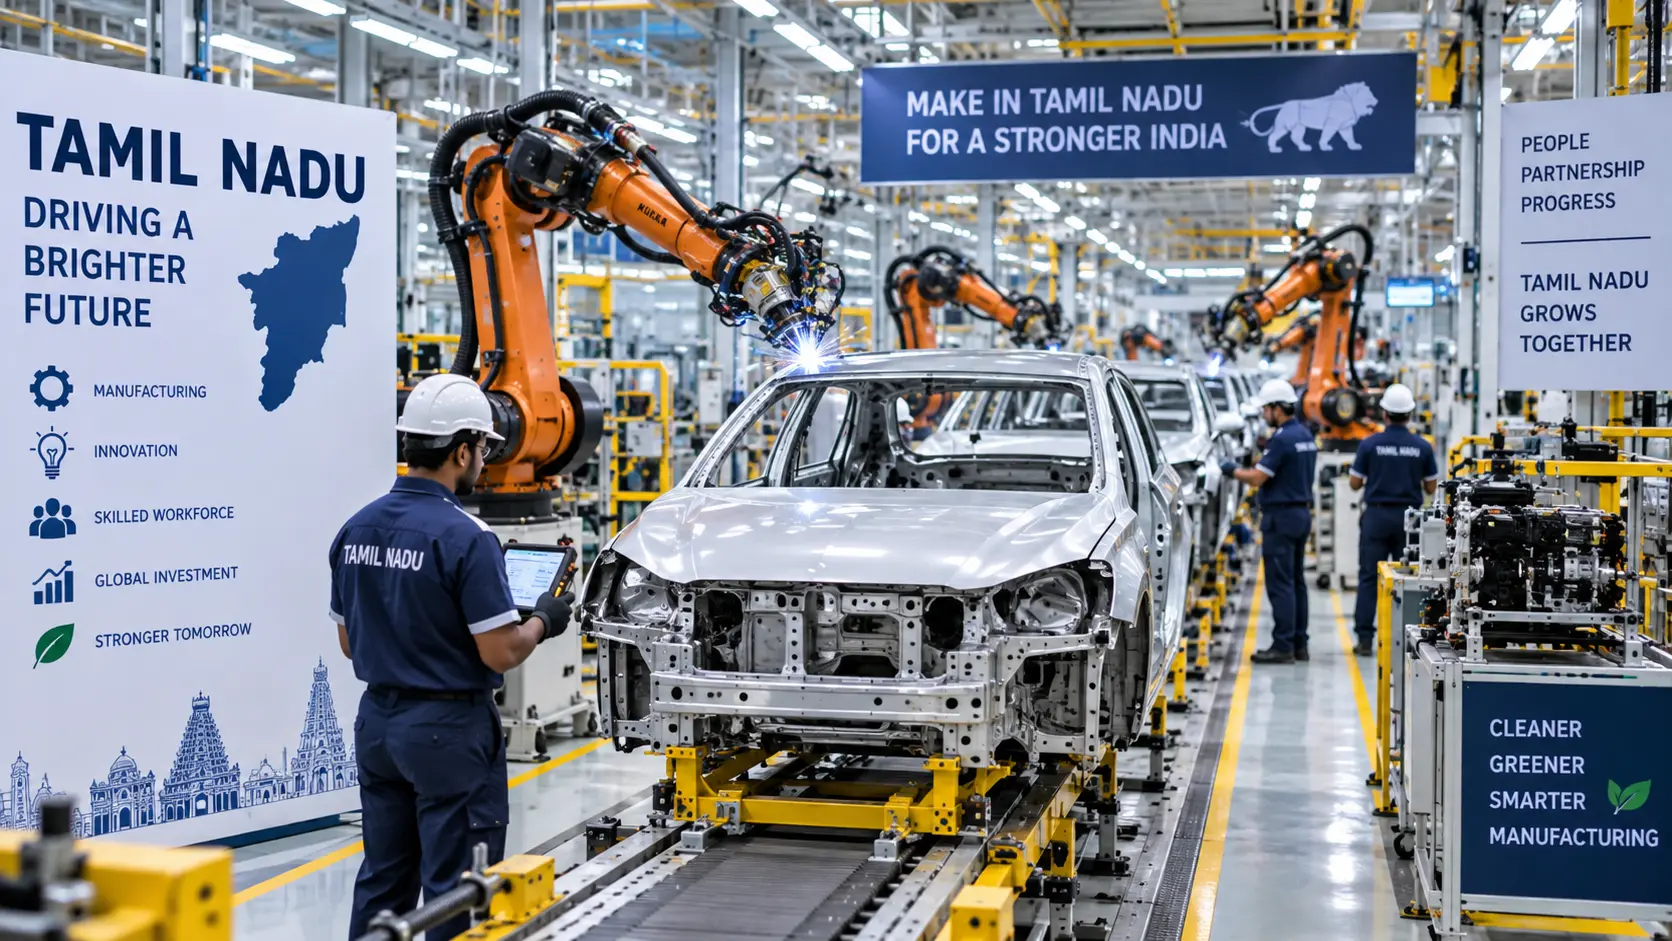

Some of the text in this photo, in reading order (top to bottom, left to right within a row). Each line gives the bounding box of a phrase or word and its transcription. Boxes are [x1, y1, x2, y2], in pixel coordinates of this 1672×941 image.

[907, 84, 1202, 117] MAKE IN TAMIL NADU
[907, 123, 1227, 155] FOR A STRONGER INDIA
[1522, 133, 1589, 153] PEOPLE
[17, 112, 364, 203] TAMIL NADU
[1522, 160, 1644, 183] PARTNERSHIP
[1522, 192, 1615, 212] PROGRESS
[25, 197, 193, 240] DRIVING A
[25, 245, 186, 284] BRIGHTER
[1521, 271, 1648, 291] TAMIL NADU
[25, 293, 151, 327] FUTURE
[1521, 304, 1596, 322] GROWS
[1520, 334, 1631, 352] TOGETHER
[94, 385, 206, 398] MANUFACTURING
[95, 445, 177, 457] INNOVATION
[95, 507, 233, 524] SKILLED WORKFORCE
[344, 545, 424, 571] TAMIL NADU
[95, 567, 238, 587] GLOBAL INVESTMENT
[96, 623, 251, 648] STRONGER TOMORROW
[1490, 719, 1581, 737] CLEANER
[1490, 755, 1584, 774] GREENER
[1490, 791, 1585, 809] SMARTER
[1490, 827, 1658, 847] MANUFACTURING
